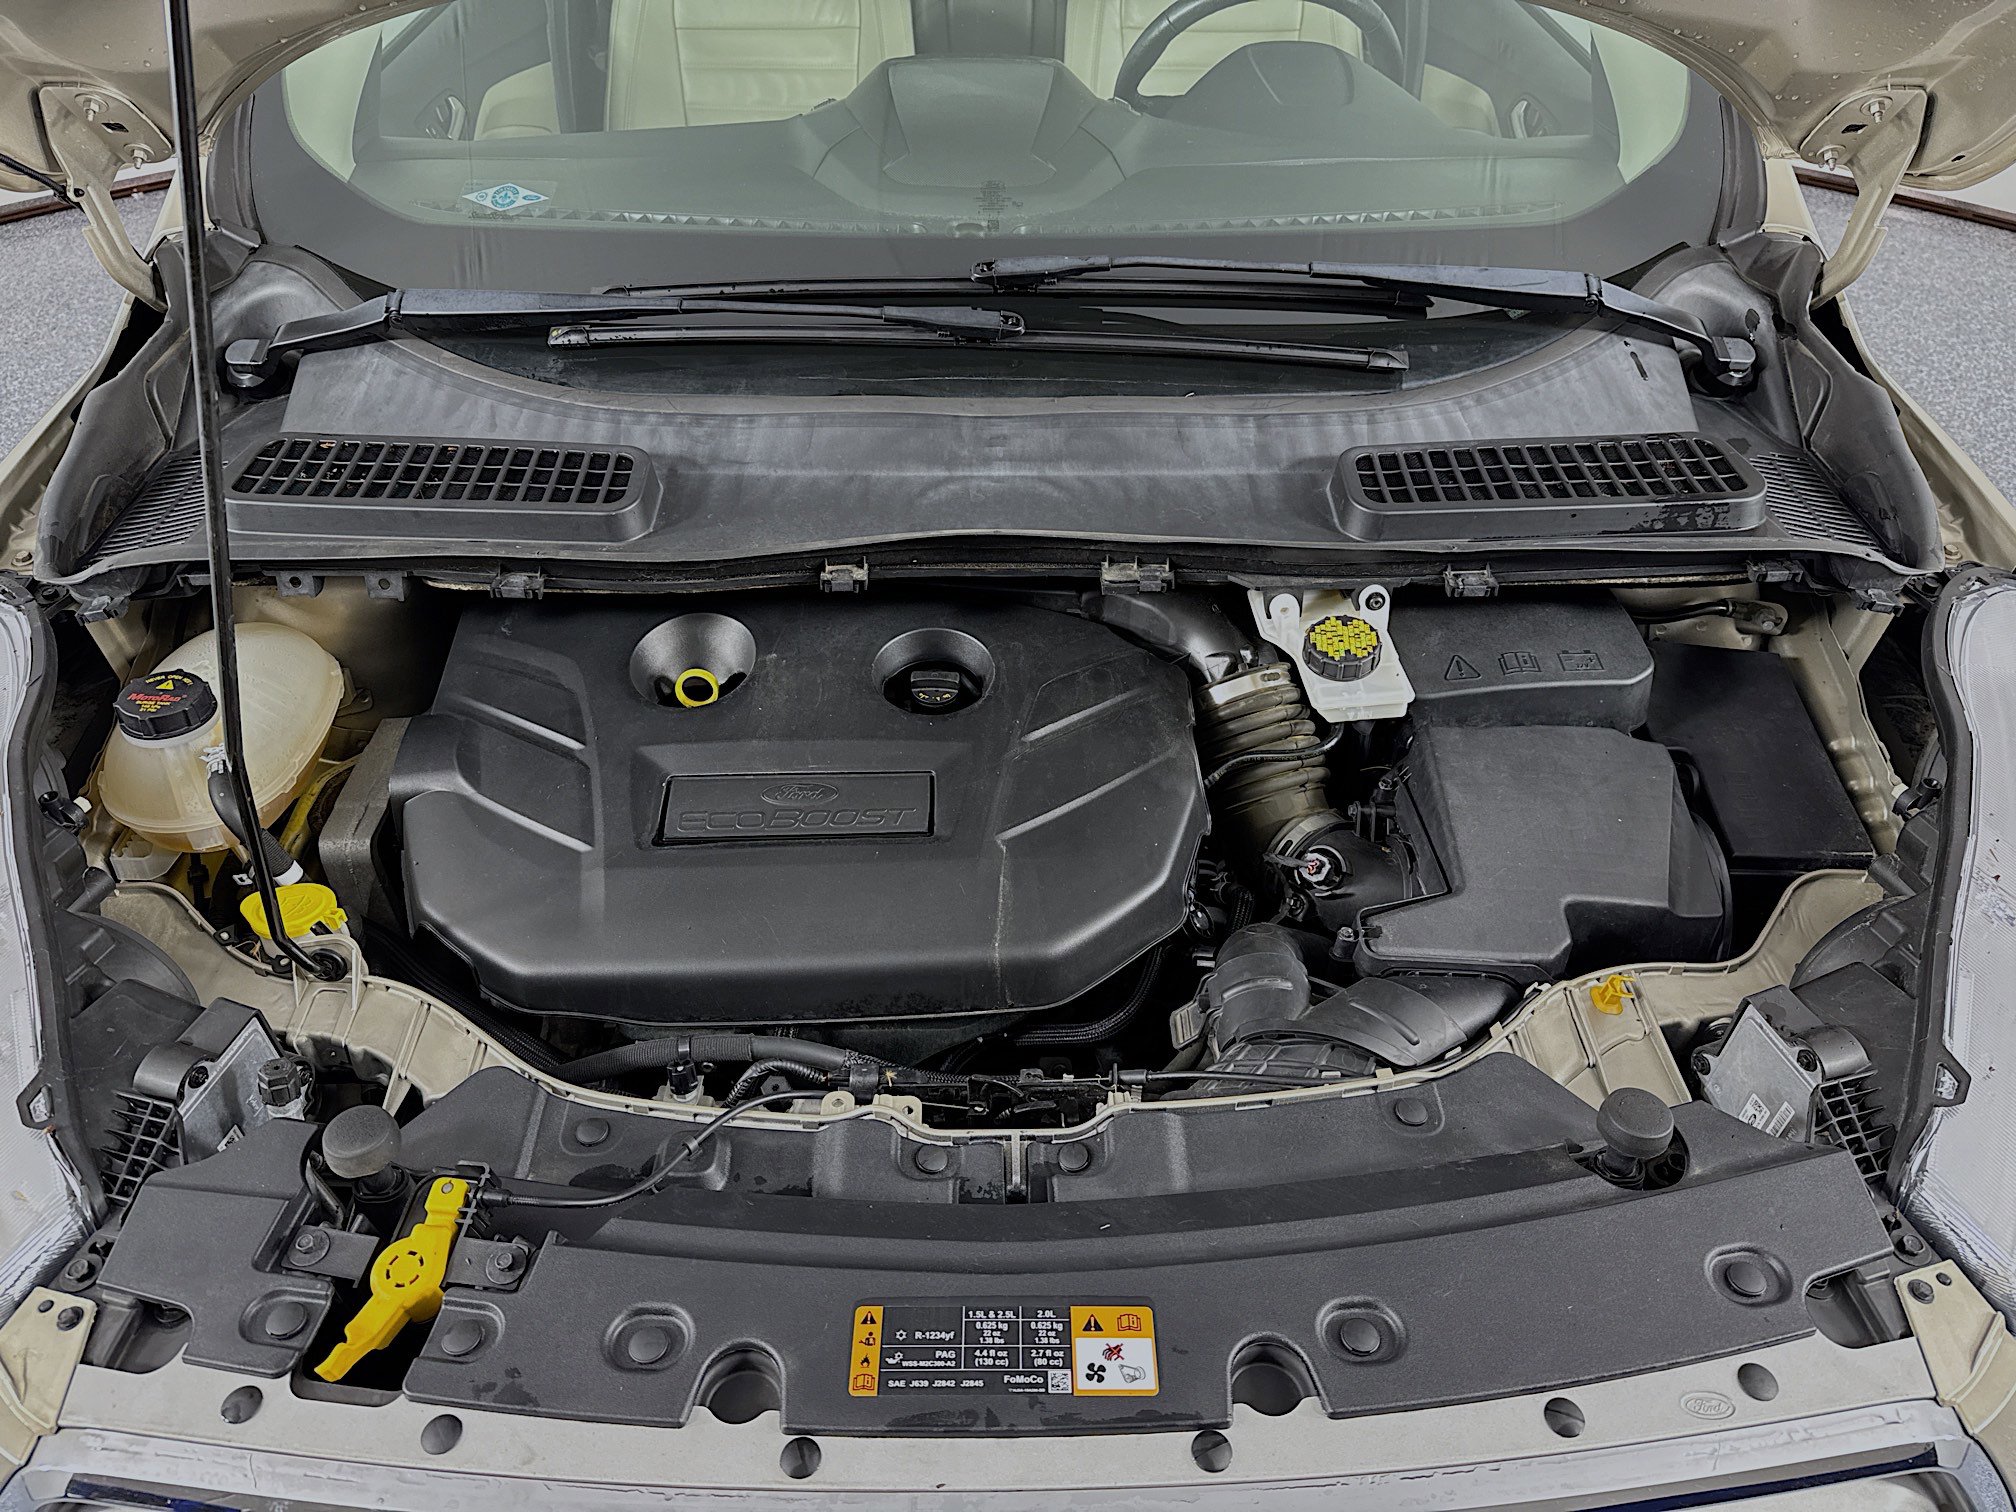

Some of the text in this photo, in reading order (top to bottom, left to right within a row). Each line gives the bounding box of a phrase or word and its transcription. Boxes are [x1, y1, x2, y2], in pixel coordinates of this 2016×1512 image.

[775, 785, 825, 800] Ford
[677, 808, 917, 832] ECOBOOST
[968, 1310, 1016, 1318] 1.5L & 2.5L
[1037, 1310, 1056, 1318] 2.0L
[975, 1321, 1008, 1331] 0.625 kg
[1030, 1321, 1063, 1331] 0.625 kg
[914, 1331, 955, 1341] R-1234yf
[935, 1350, 956, 1358] PAG
[974, 1349, 988, 1357] 4.4
[989, 1349, 996, 1357] fl
[1030, 1349, 1044, 1357] 2.7
[1045, 1349, 1052, 1357] fl
[974, 1358, 1009, 1367] (130 cc)
[1033, 1358, 1063, 1367] (80 cc)
[1003, 1375, 1044, 1384] FoMoCo
